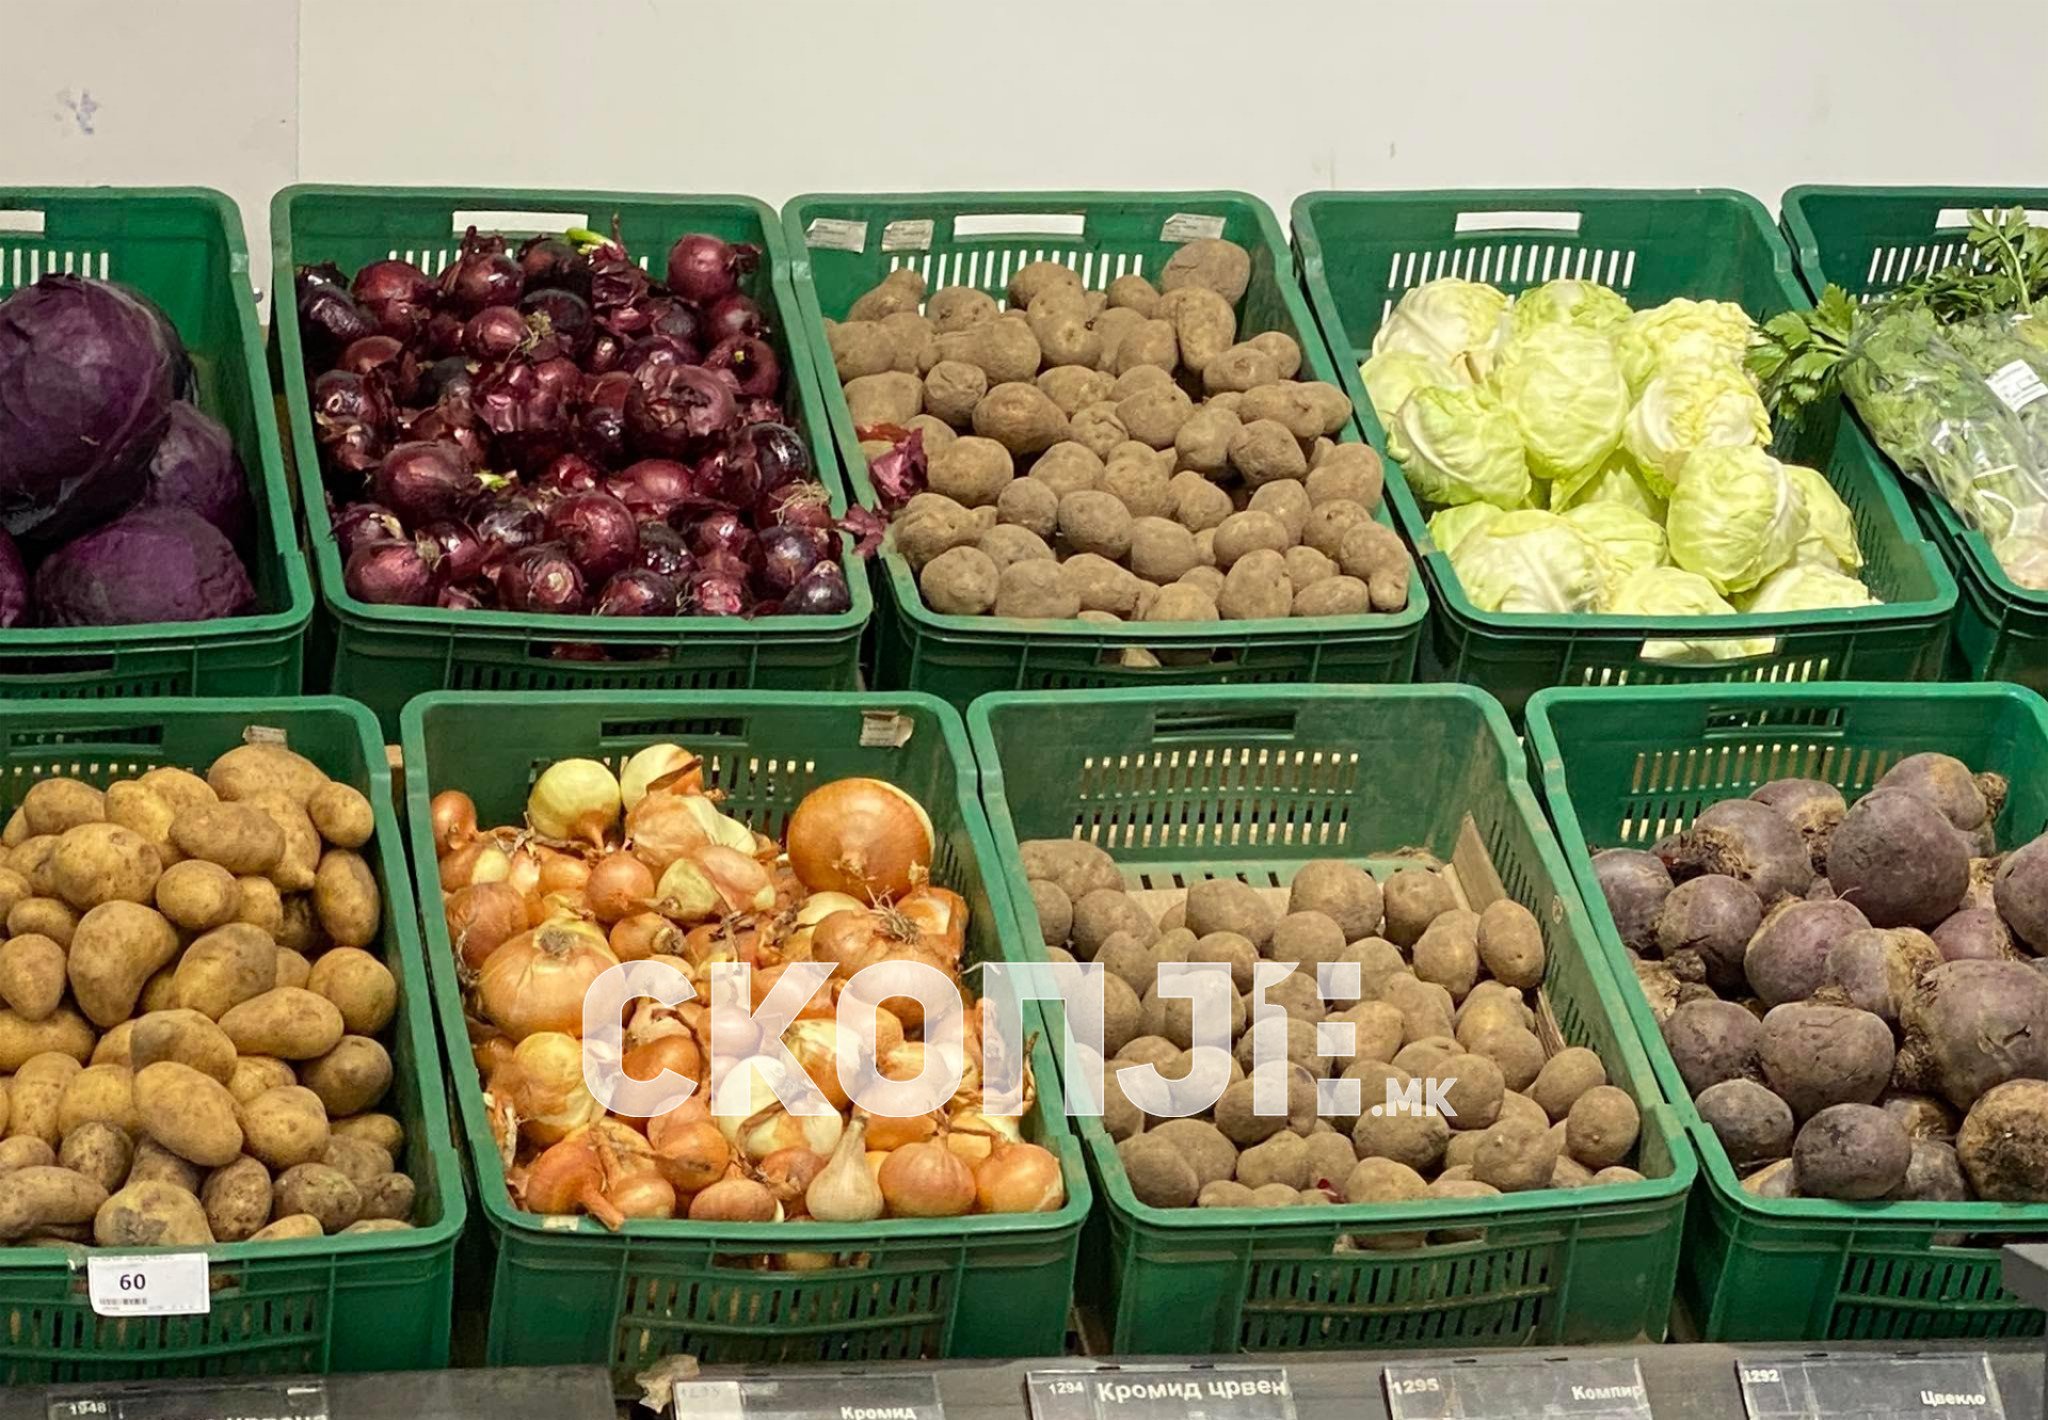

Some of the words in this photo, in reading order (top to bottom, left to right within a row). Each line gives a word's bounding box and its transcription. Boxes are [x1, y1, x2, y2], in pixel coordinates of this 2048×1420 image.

[120, 1273, 146, 1290] 60
[1743, 1369, 1780, 1383] 1292
[1049, 1381, 1084, 1395] 1294
[1098, 1382, 1202, 1403] Кромид
[1208, 1379, 1287, 1400] црвен
[1393, 1378, 1439, 1394] 1295
[1571, 1385, 1645, 1401] Компир
[1920, 1390, 1986, 1407] Цвекло
[840, 1406, 917, 1420] Кромид
